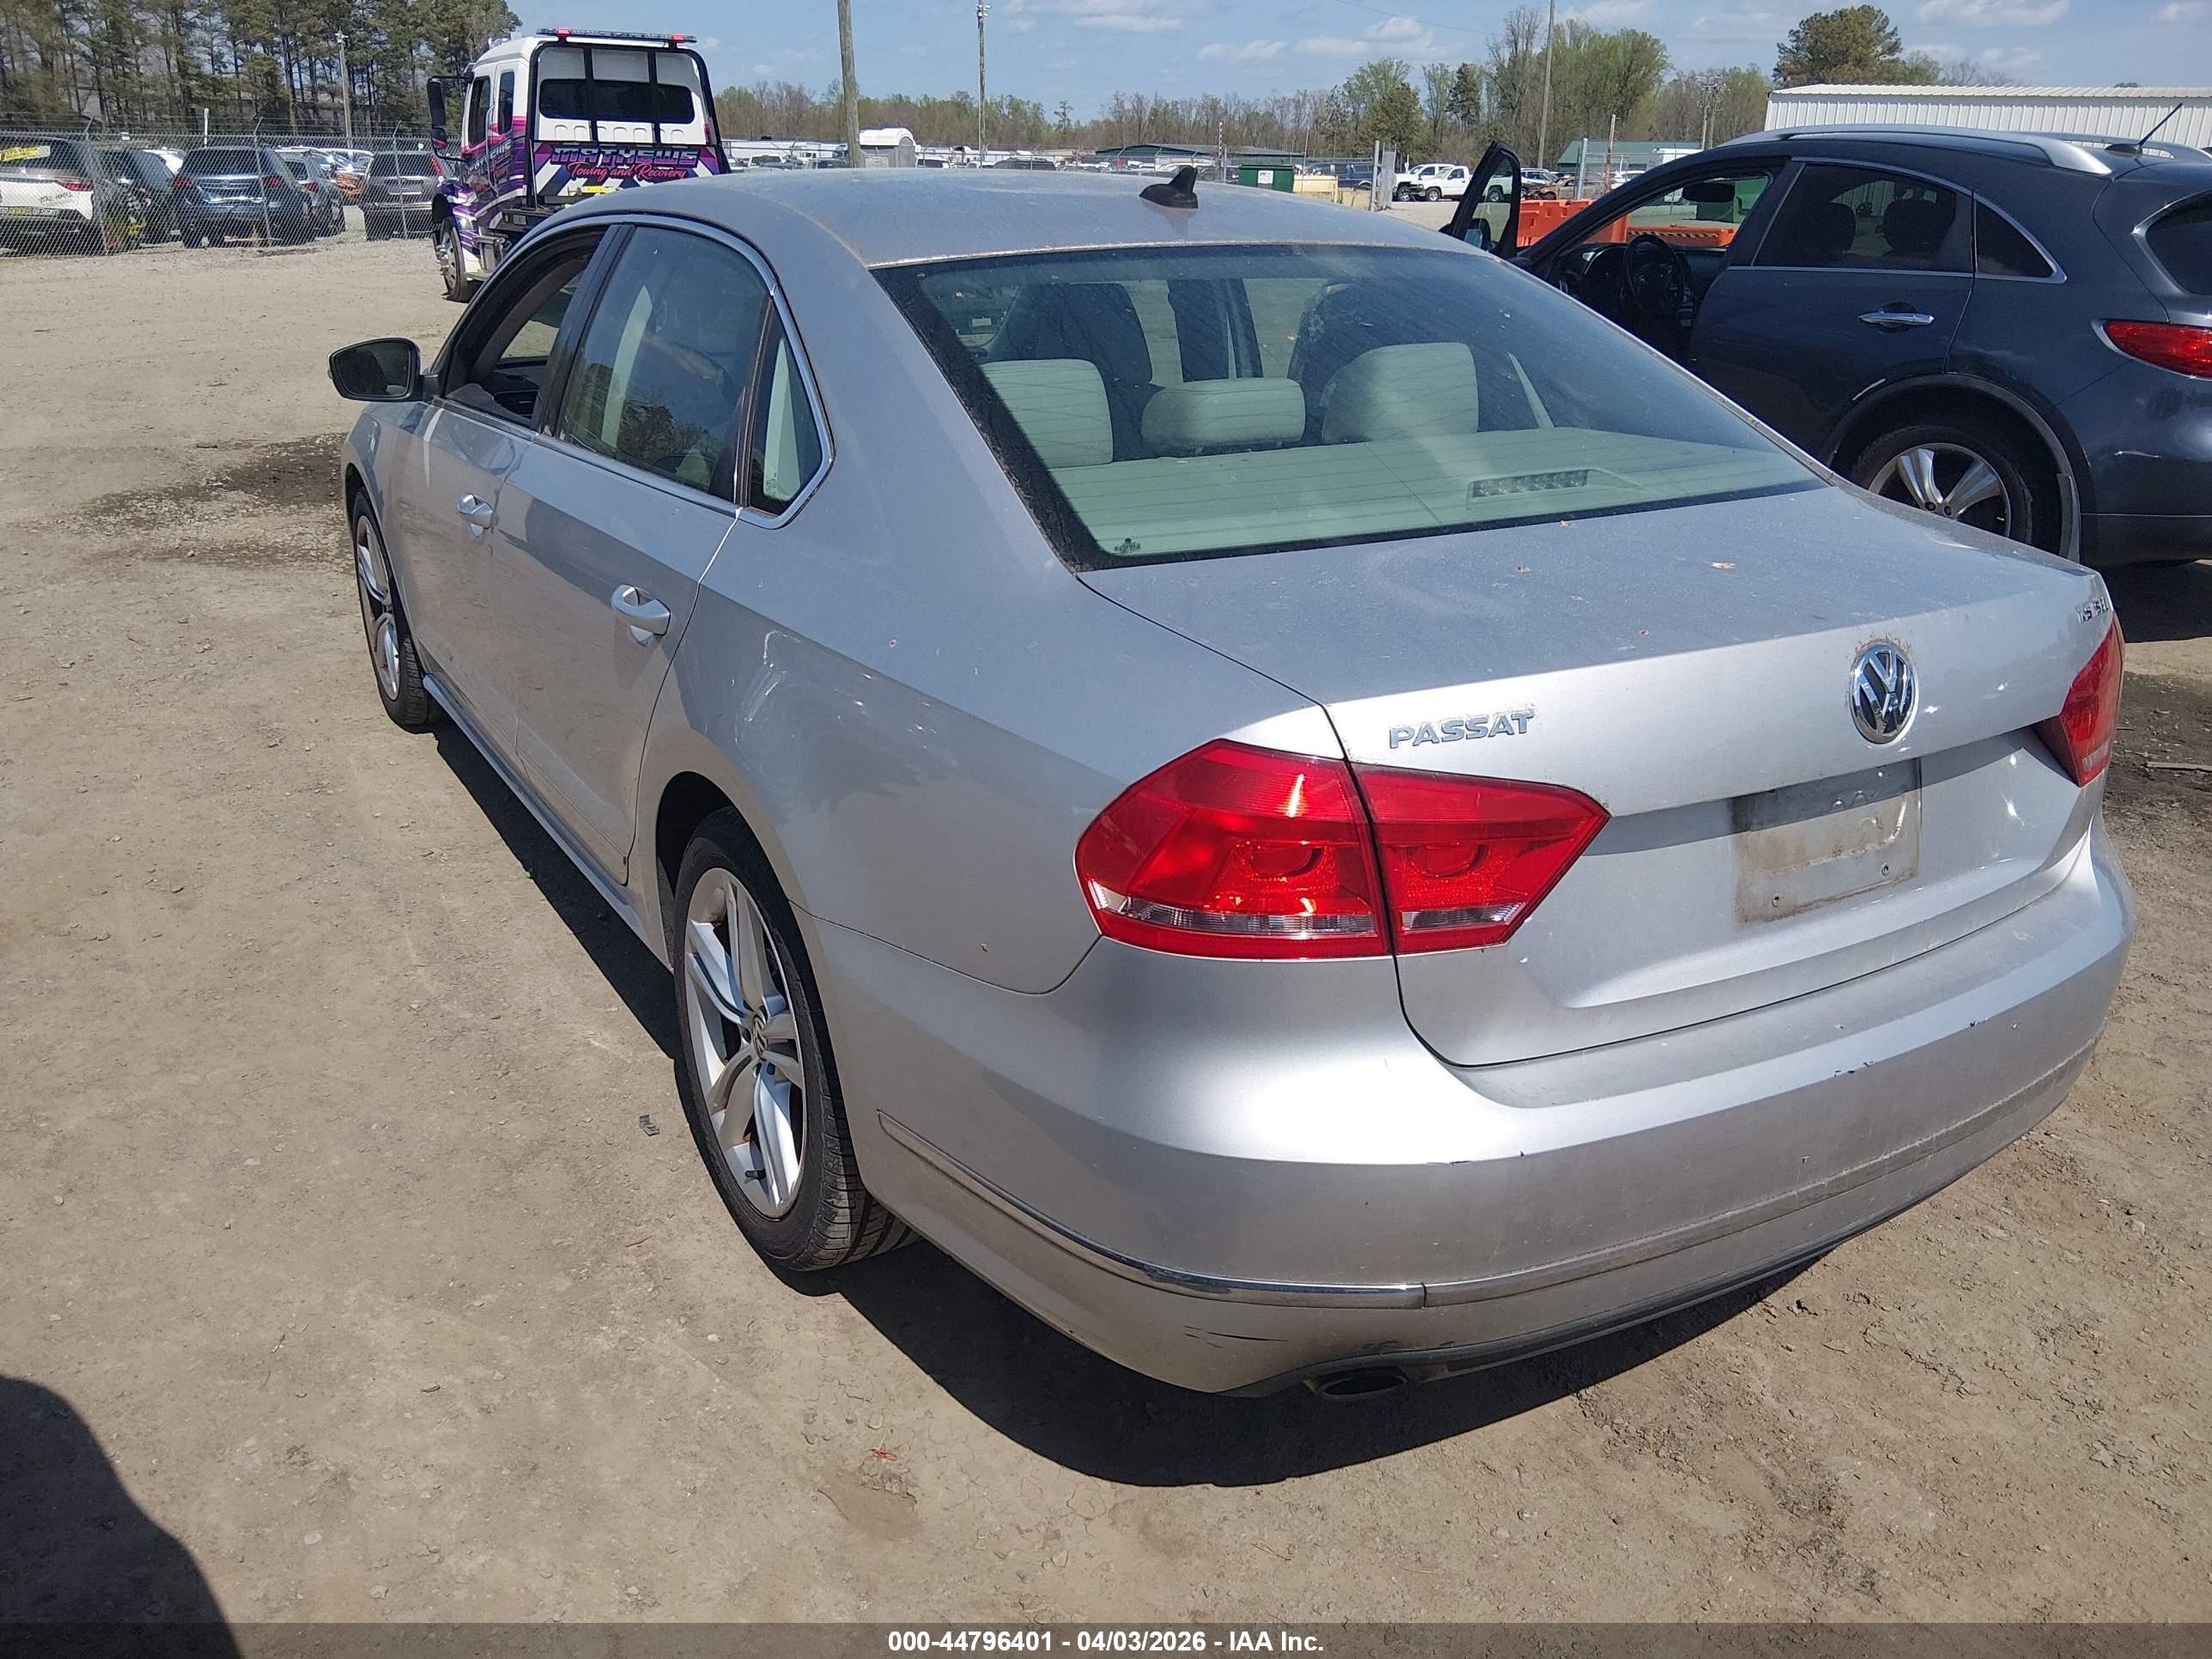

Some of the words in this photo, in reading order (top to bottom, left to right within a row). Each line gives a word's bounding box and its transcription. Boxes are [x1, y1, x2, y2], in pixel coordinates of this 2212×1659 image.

[550, 146, 699, 166] MATHEWS
[568, 162, 609, 181] Towing
[610, 165, 634, 176] and
[634, 164, 687, 179] Recovery
[1389, 713, 1534, 749] PASSAT
